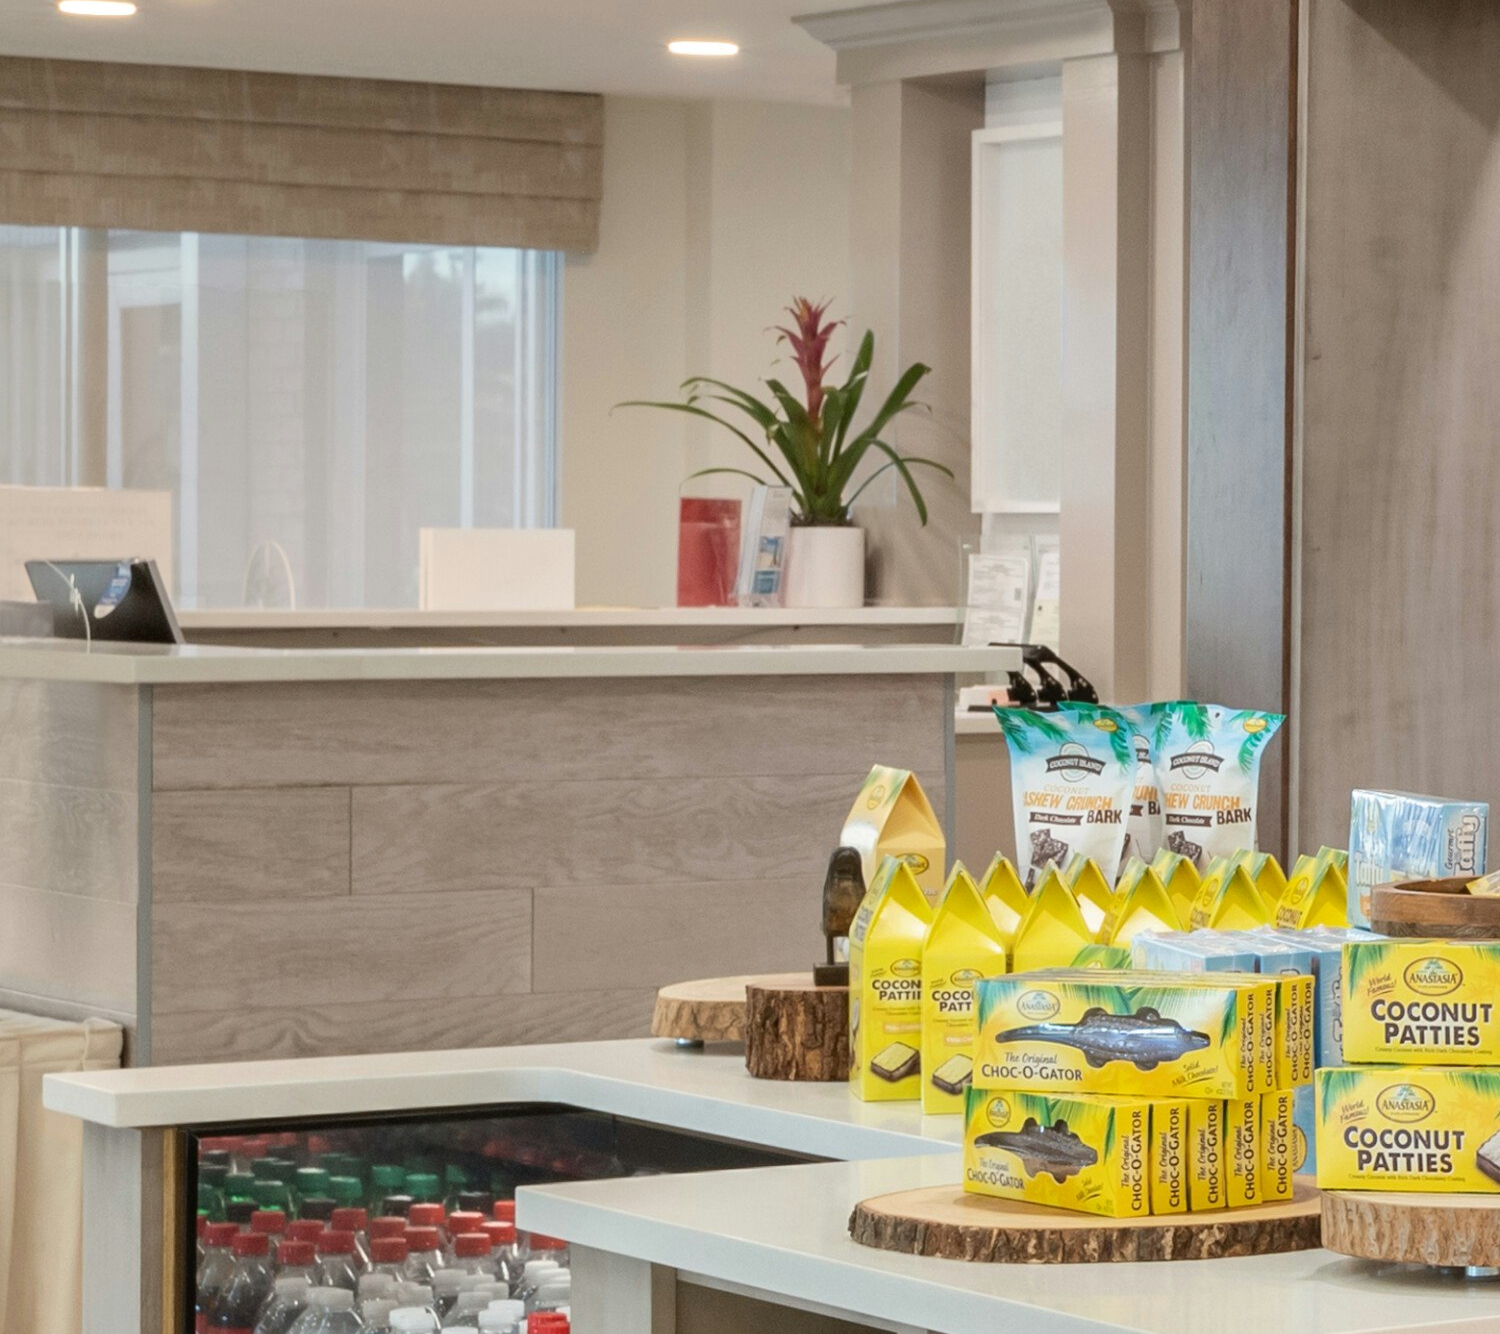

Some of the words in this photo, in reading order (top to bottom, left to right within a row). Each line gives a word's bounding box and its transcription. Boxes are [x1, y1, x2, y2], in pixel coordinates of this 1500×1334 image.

[1066, 793, 1112, 810] CRUNCH
[1192, 793, 1241, 810] CRUNCH
[1086, 809, 1123, 824] BARK
[1216, 808, 1252, 825] BARK
[871, 977, 922, 992] COCON
[1408, 972, 1458, 986] ANASTASIA
[938, 999, 972, 1014] PATT
[1370, 998, 1493, 1024] COCONUT
[1384, 1022, 1481, 1047] PATTIES
[1004, 1051, 1024, 1064] The
[1026, 1053, 1058, 1069] Original
[981, 1063, 1083, 1083] CHOC-O-GATOR
[1381, 1098, 1430, 1112] ANASTASIA
[1343, 1125, 1466, 1151] COCONUT
[1131, 1109, 1142, 1211] CHOC-O-GATOR
[1169, 1106, 1180, 1208] CHOC-O-GATOR
[1208, 1104, 1218, 1205] CHOC-O-GATOR
[1356, 1148, 1454, 1174] PATTIES
